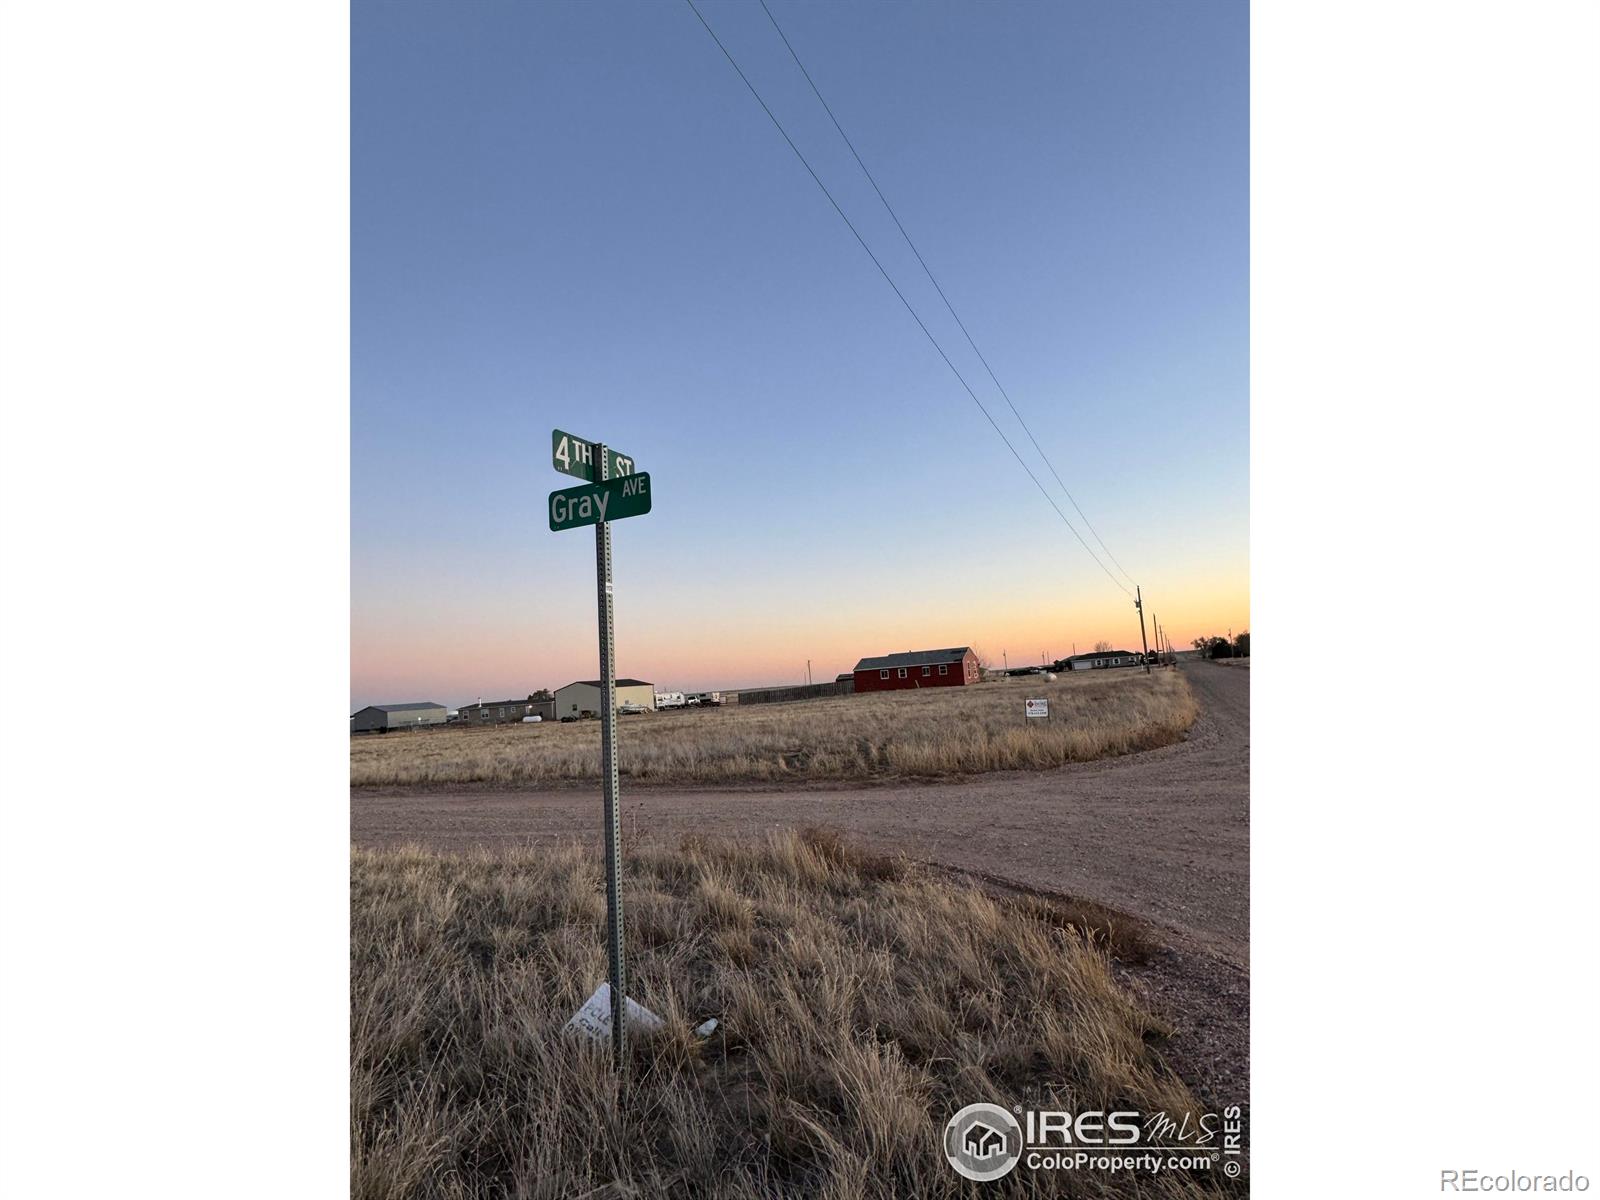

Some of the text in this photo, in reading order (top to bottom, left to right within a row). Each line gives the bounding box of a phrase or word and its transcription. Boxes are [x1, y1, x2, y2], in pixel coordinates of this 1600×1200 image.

[555, 436, 632, 478] 4TH ST
[552, 476, 647, 523] Gray AVE
